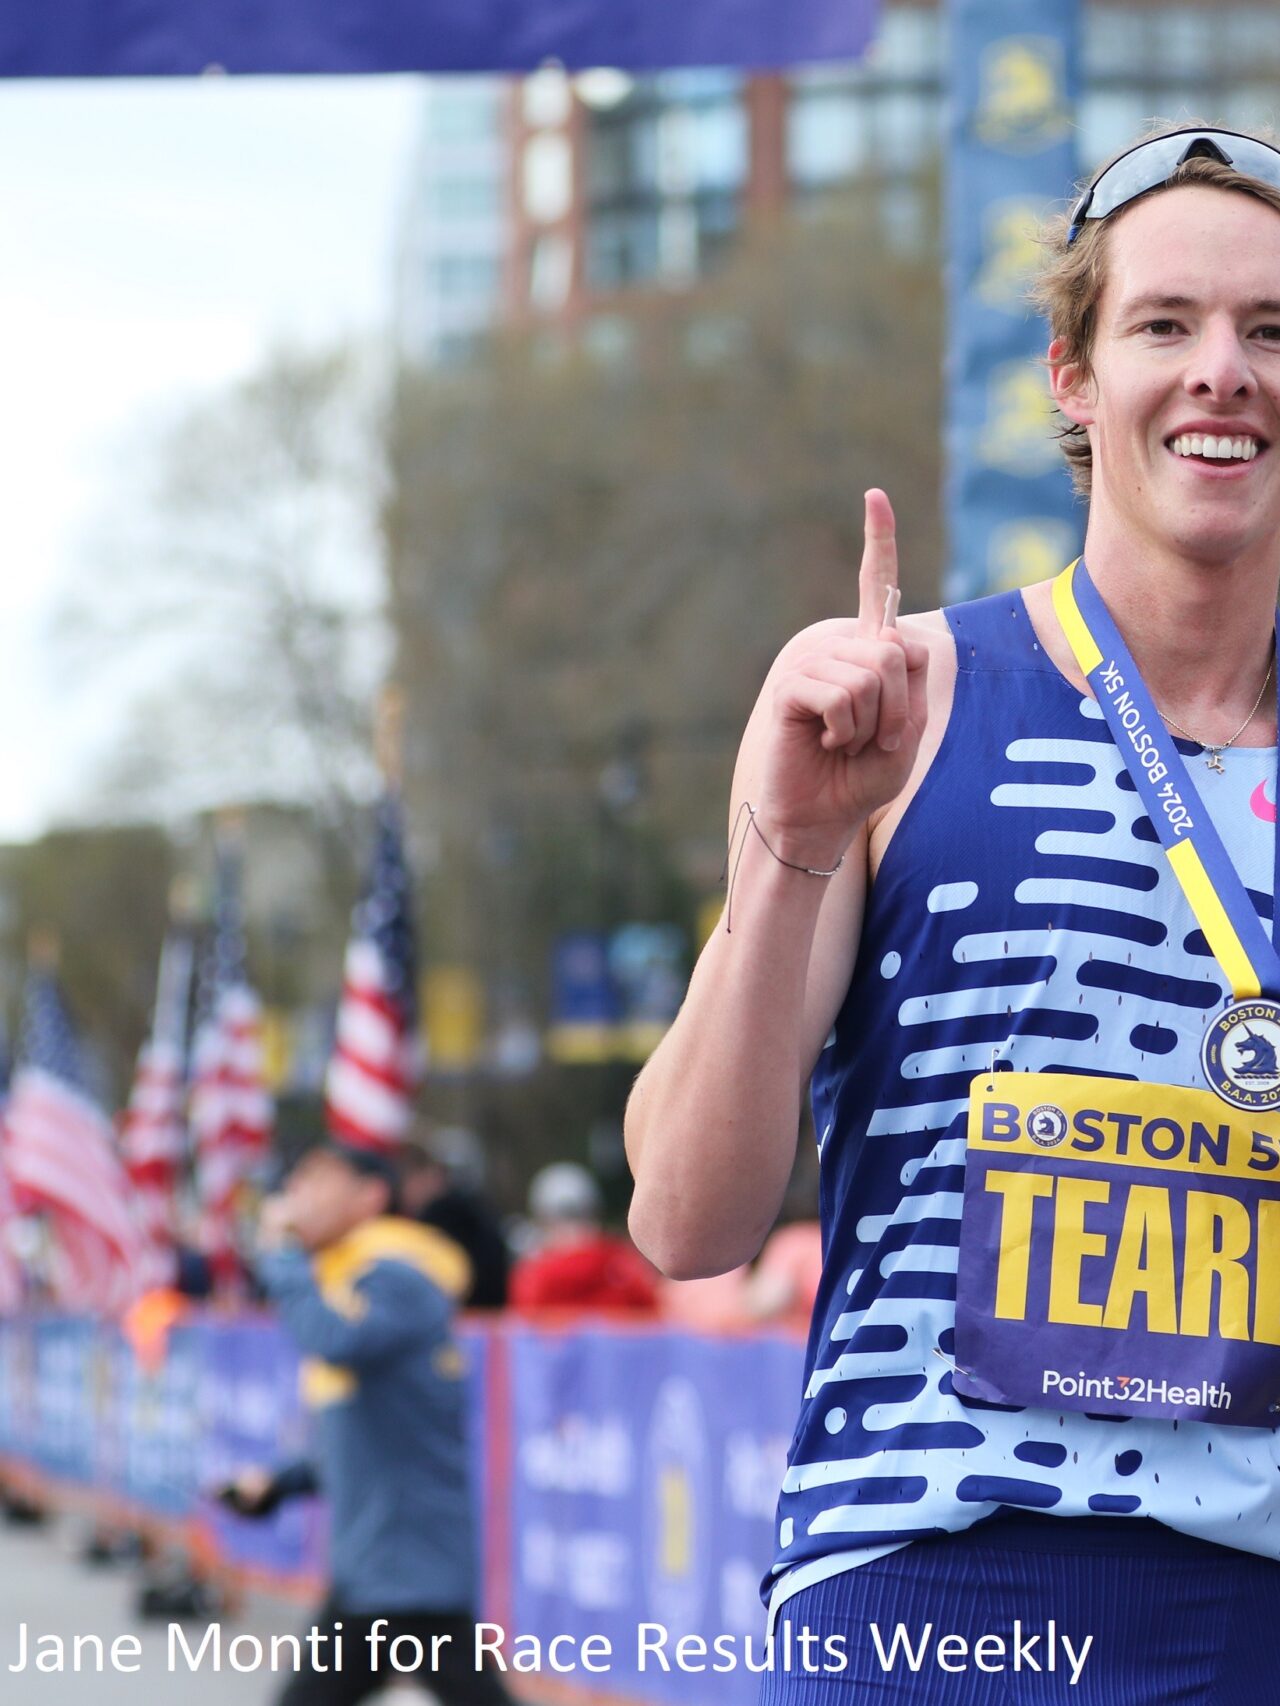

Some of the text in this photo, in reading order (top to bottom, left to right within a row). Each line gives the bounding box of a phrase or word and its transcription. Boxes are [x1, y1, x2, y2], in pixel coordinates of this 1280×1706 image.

[1099, 659, 1194, 837] 2024 BOSTON 5K
[1219, 1006, 1277, 1033] BOSTON
[1221, 1080, 1257, 1104] B.A.A.
[981, 1102, 1229, 1167] BOSTON
[1041, 1369, 1232, 1410] Point32Health
